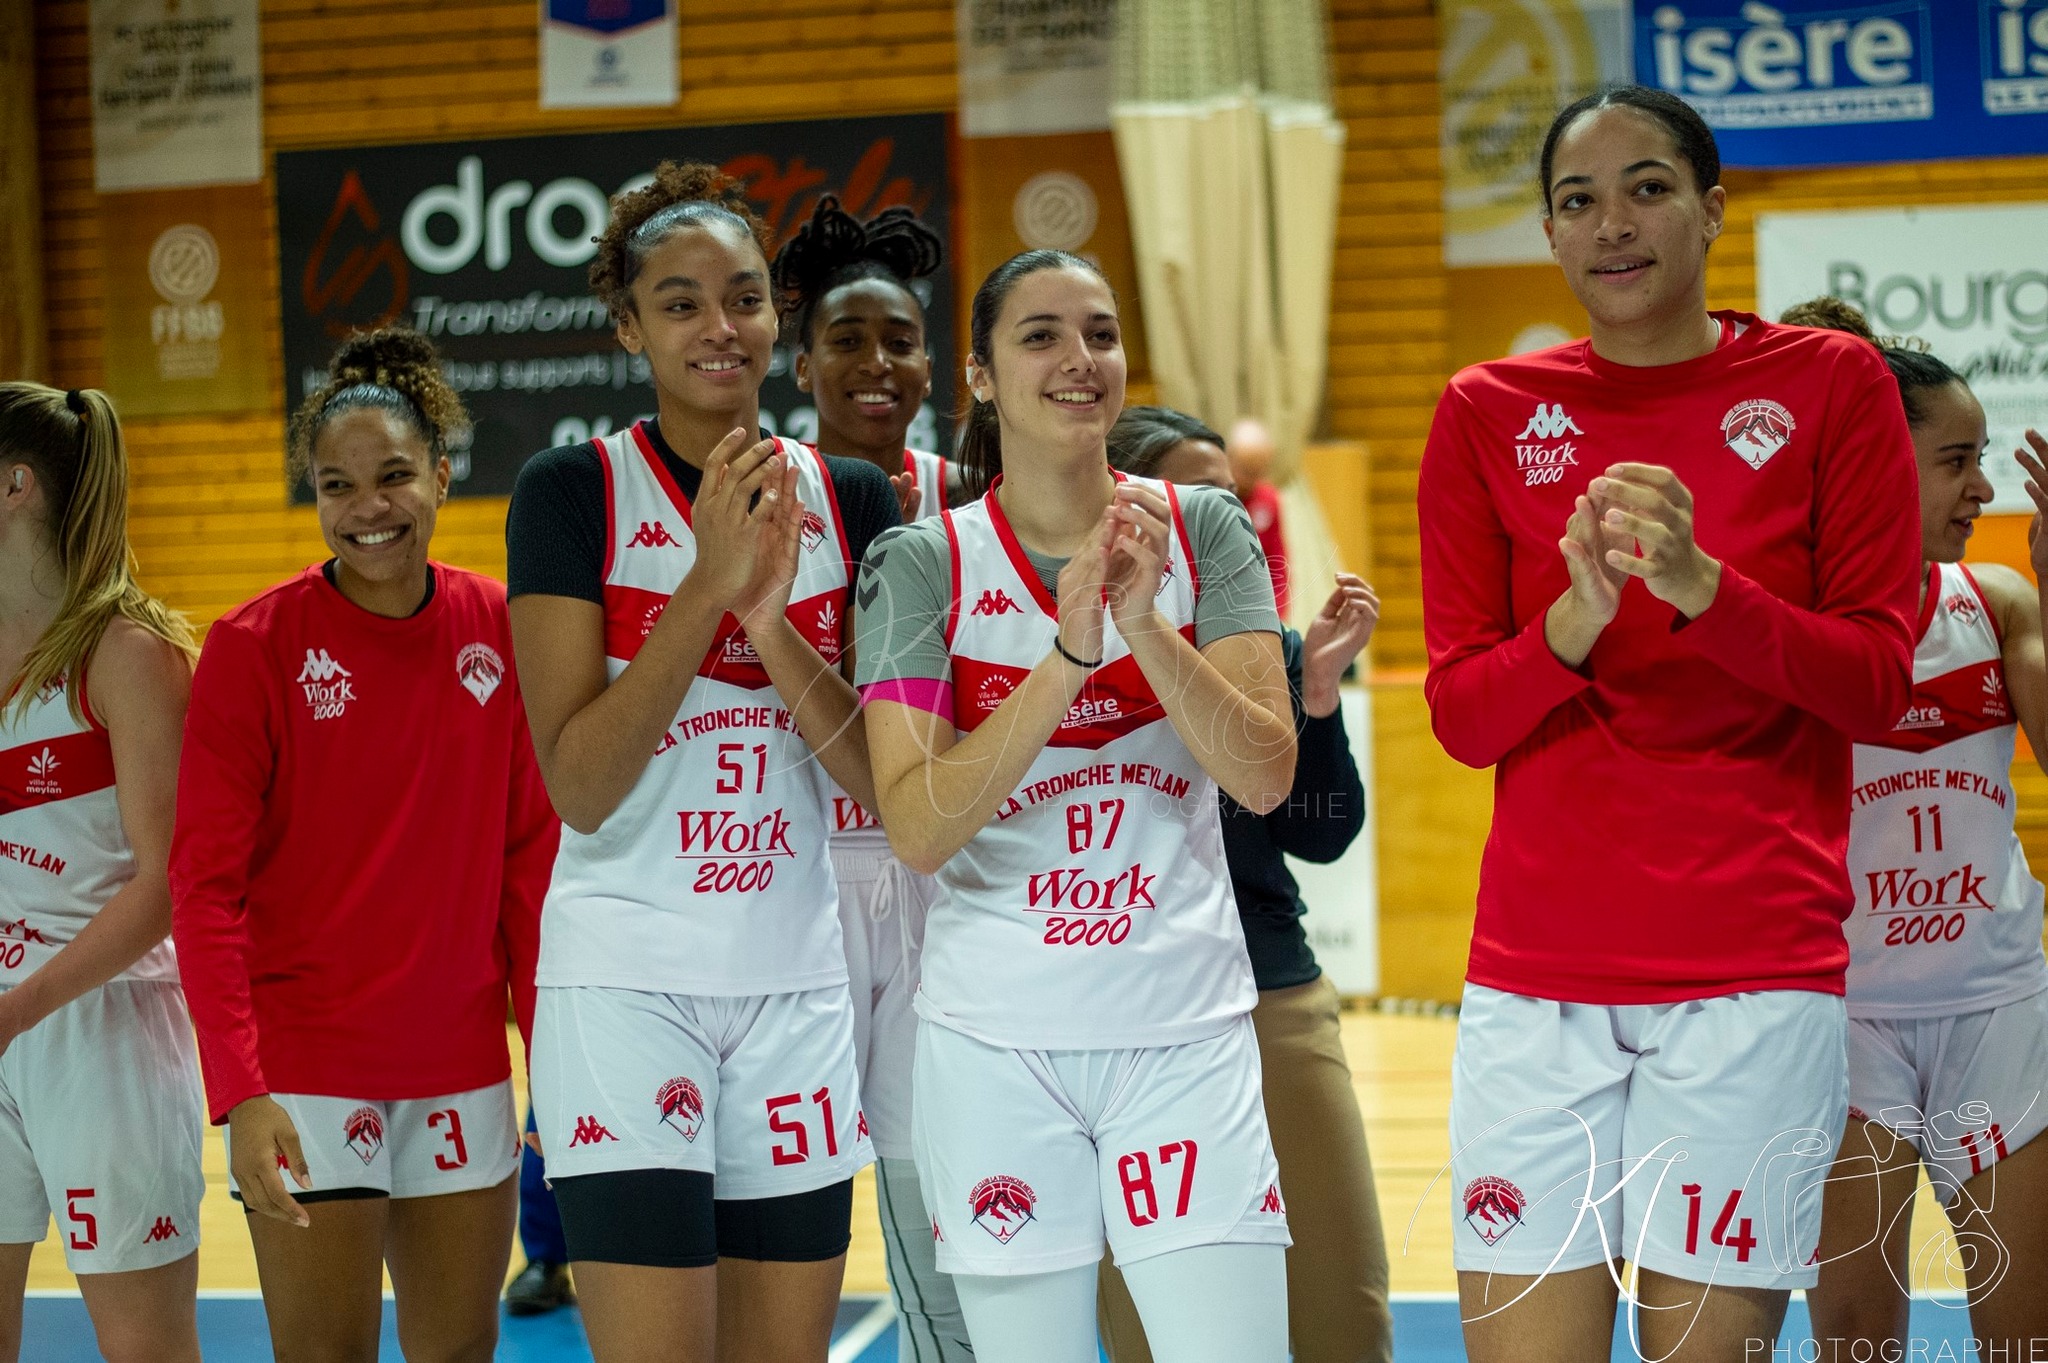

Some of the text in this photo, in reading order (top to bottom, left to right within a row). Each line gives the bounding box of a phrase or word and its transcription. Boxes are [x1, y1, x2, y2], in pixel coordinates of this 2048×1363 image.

[1653, 2, 1914, 96] isère
[402, 154, 655, 275] dro
[412, 289, 618, 337] Transform
[1514, 441, 1580, 467] Work
[1525, 466, 1564, 487] 2000
[725, 637, 757, 656] isè
[302, 678, 357, 703] Work
[314, 701, 346, 721] 2000
[677, 707, 772, 741] TRONCHE
[26, 786, 62, 794] meylan
[716, 743, 768, 794] 51
[996, 763, 1190, 821] LA TRONCHE MEYLAN
[1852, 769, 2007, 810] TRONCHE MEYLAN
[677, 807, 797, 859] Work
[1065, 797, 1125, 855] 87
[1906, 803, 1943, 853] 11
[693, 859, 774, 893] 2000
[1027, 862, 1156, 911] Work
[1865, 862, 1995, 912] Work
[1043, 913, 1132, 946] 2000
[1885, 912, 1966, 947] 2000
[427, 1109, 468, 1171] 3
[765, 1086, 838, 1167] 51
[1960, 1122, 2009, 1176] 11
[1117, 1139, 1199, 1227] 87
[66, 1188, 98, 1251] 5
[1681, 1182, 1757, 1263] 14
